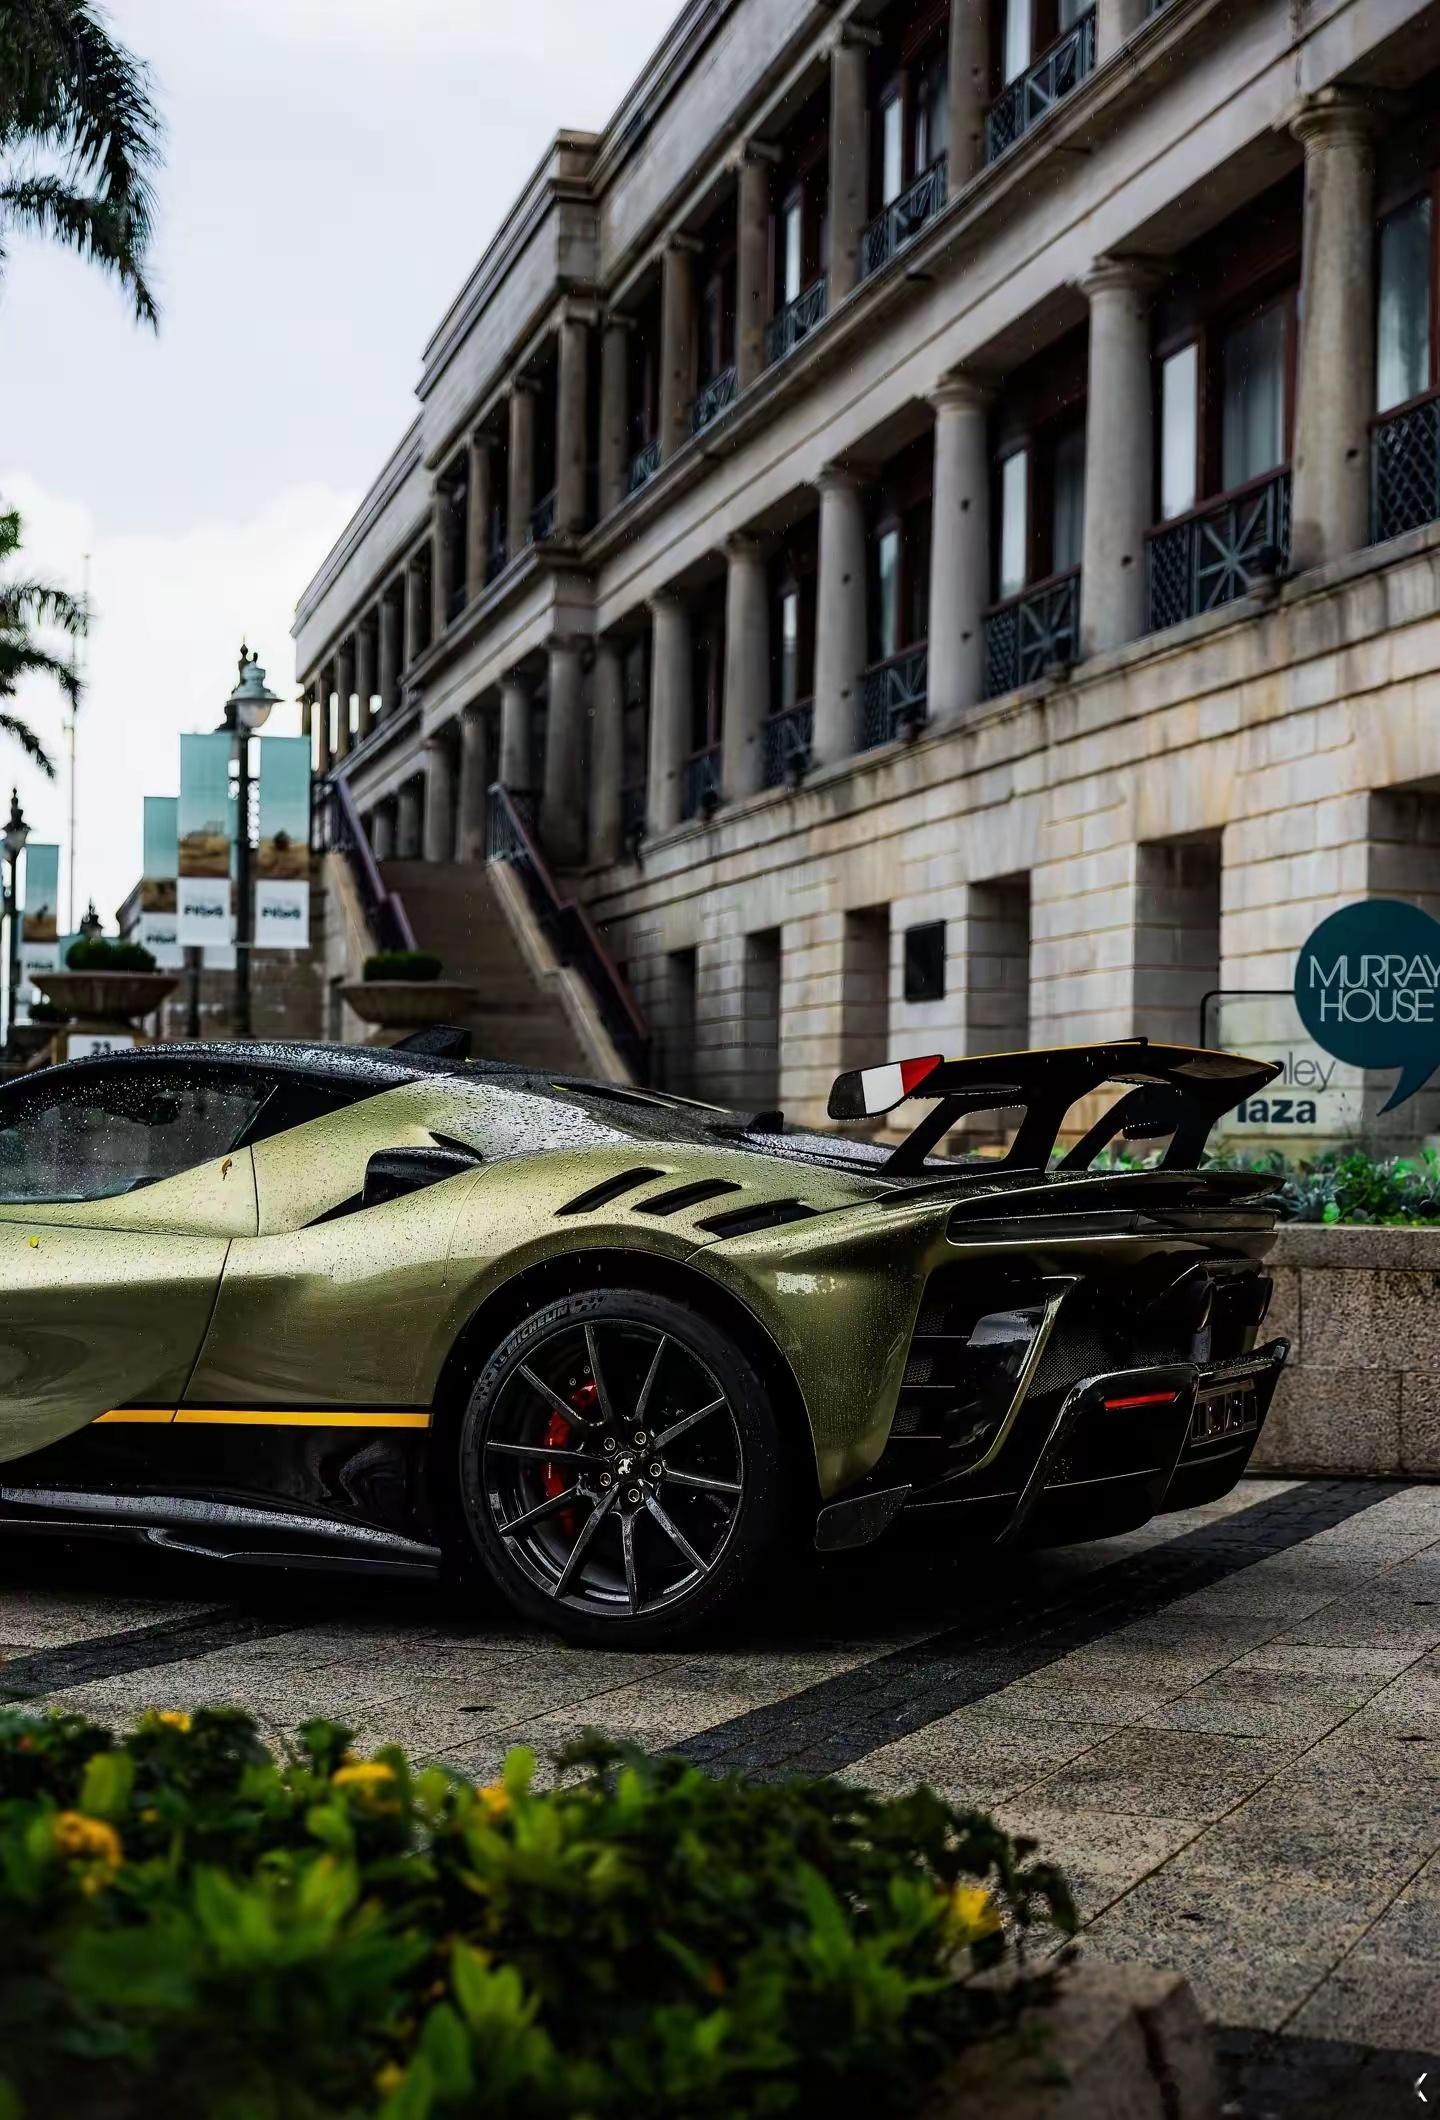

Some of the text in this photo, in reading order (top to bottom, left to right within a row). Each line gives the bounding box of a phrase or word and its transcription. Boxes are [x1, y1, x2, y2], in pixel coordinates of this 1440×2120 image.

[1309, 954, 1440, 988] MURRAY
[1319, 988, 1435, 1023] HOUSE
[1236, 1098, 1317, 1124] laza
[506, 1303, 569, 1354] MICHELIN
